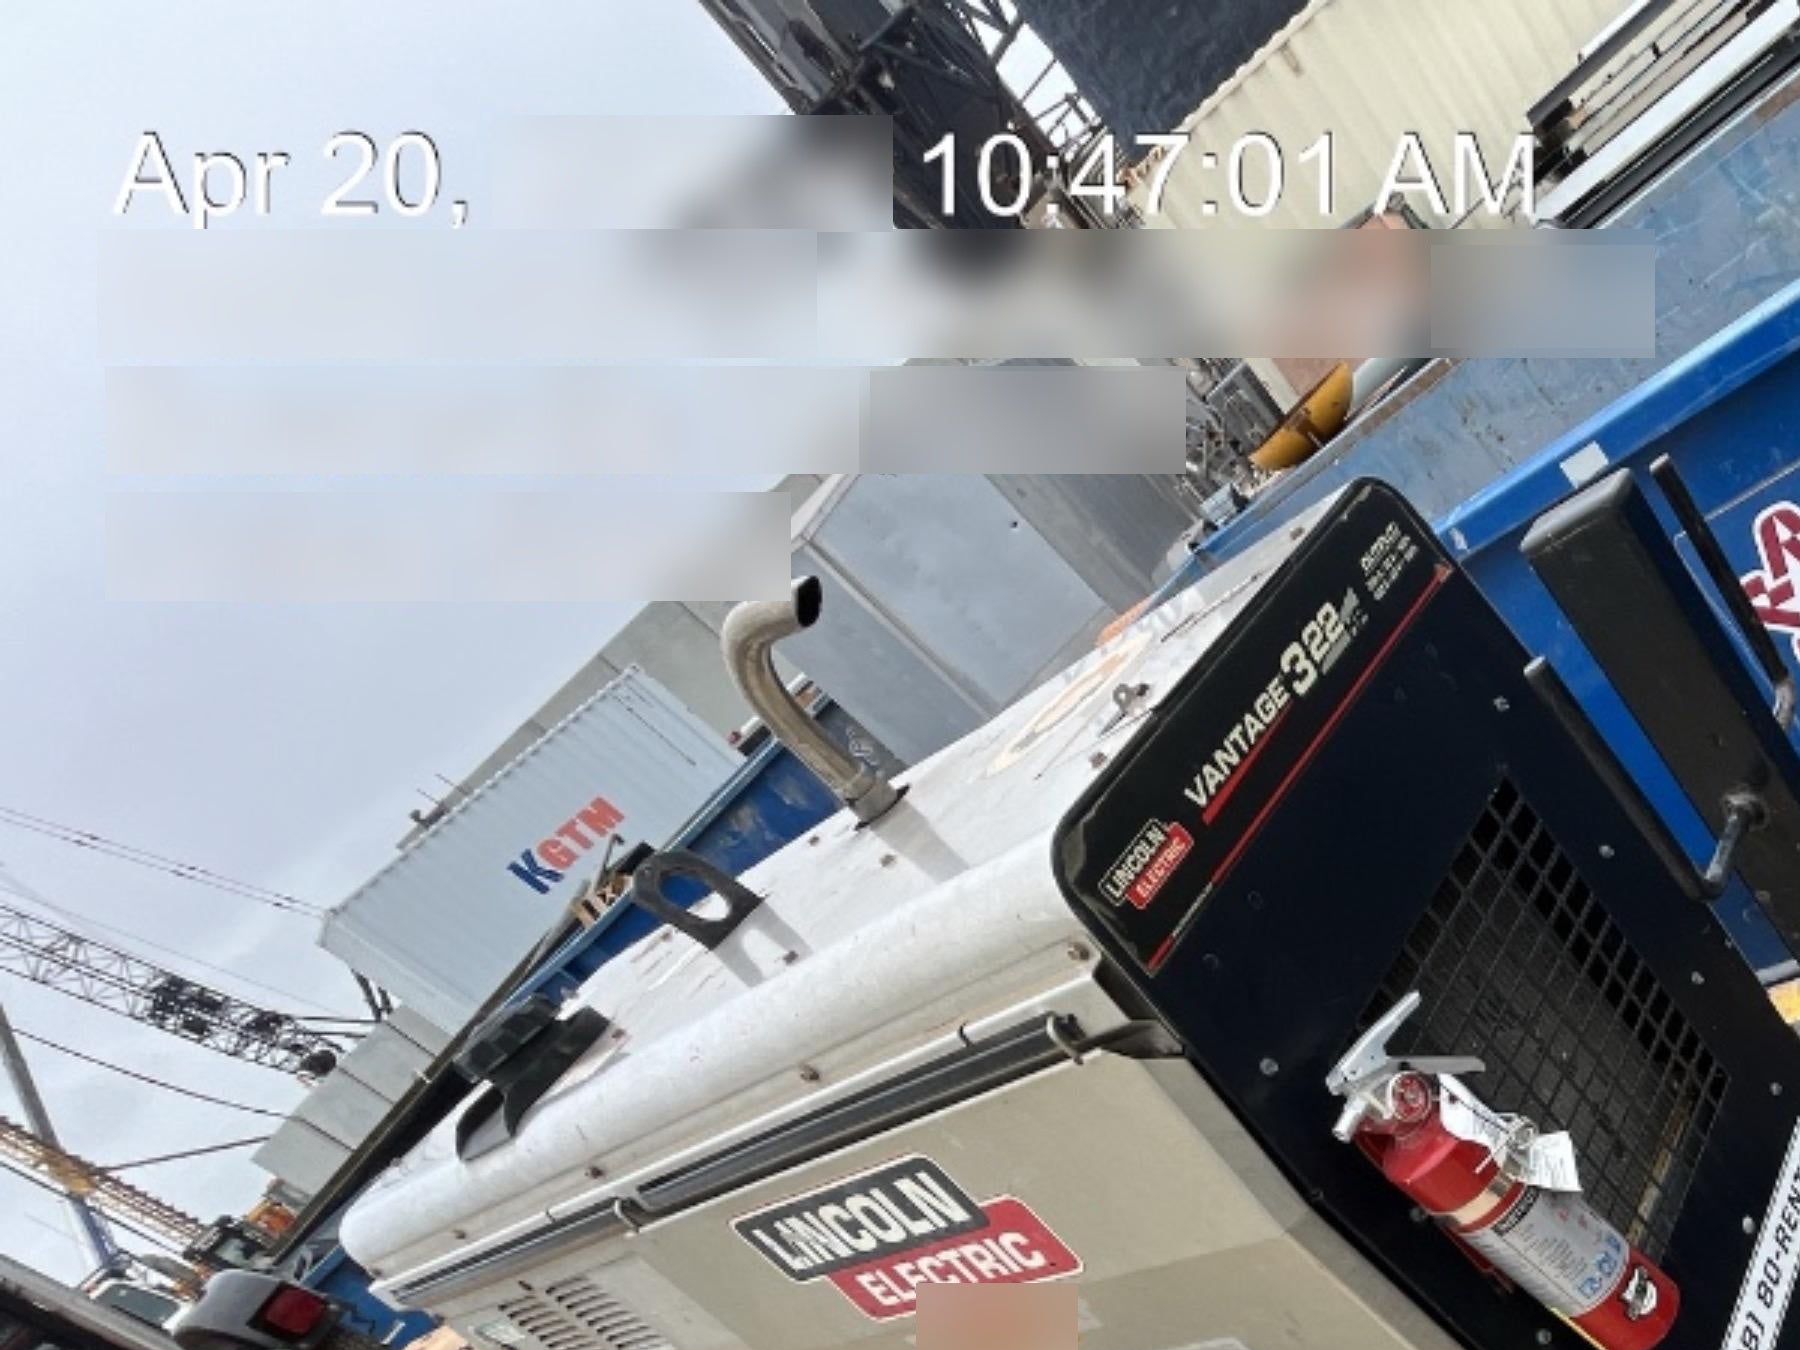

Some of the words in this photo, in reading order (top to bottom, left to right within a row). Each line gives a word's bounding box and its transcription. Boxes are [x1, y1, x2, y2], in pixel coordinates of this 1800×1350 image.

[1184, 678, 1291, 808] VANTAGE
[1280, 602, 1346, 697] 322
[506, 796, 625, 895] KGTM
[1104, 825, 1169, 900] LINCOLN
[1135, 836, 1188, 899] ELECTRIC
[752, 1170, 973, 1271] LINCOLN
[855, 1231, 1047, 1306] ELECTRIC
